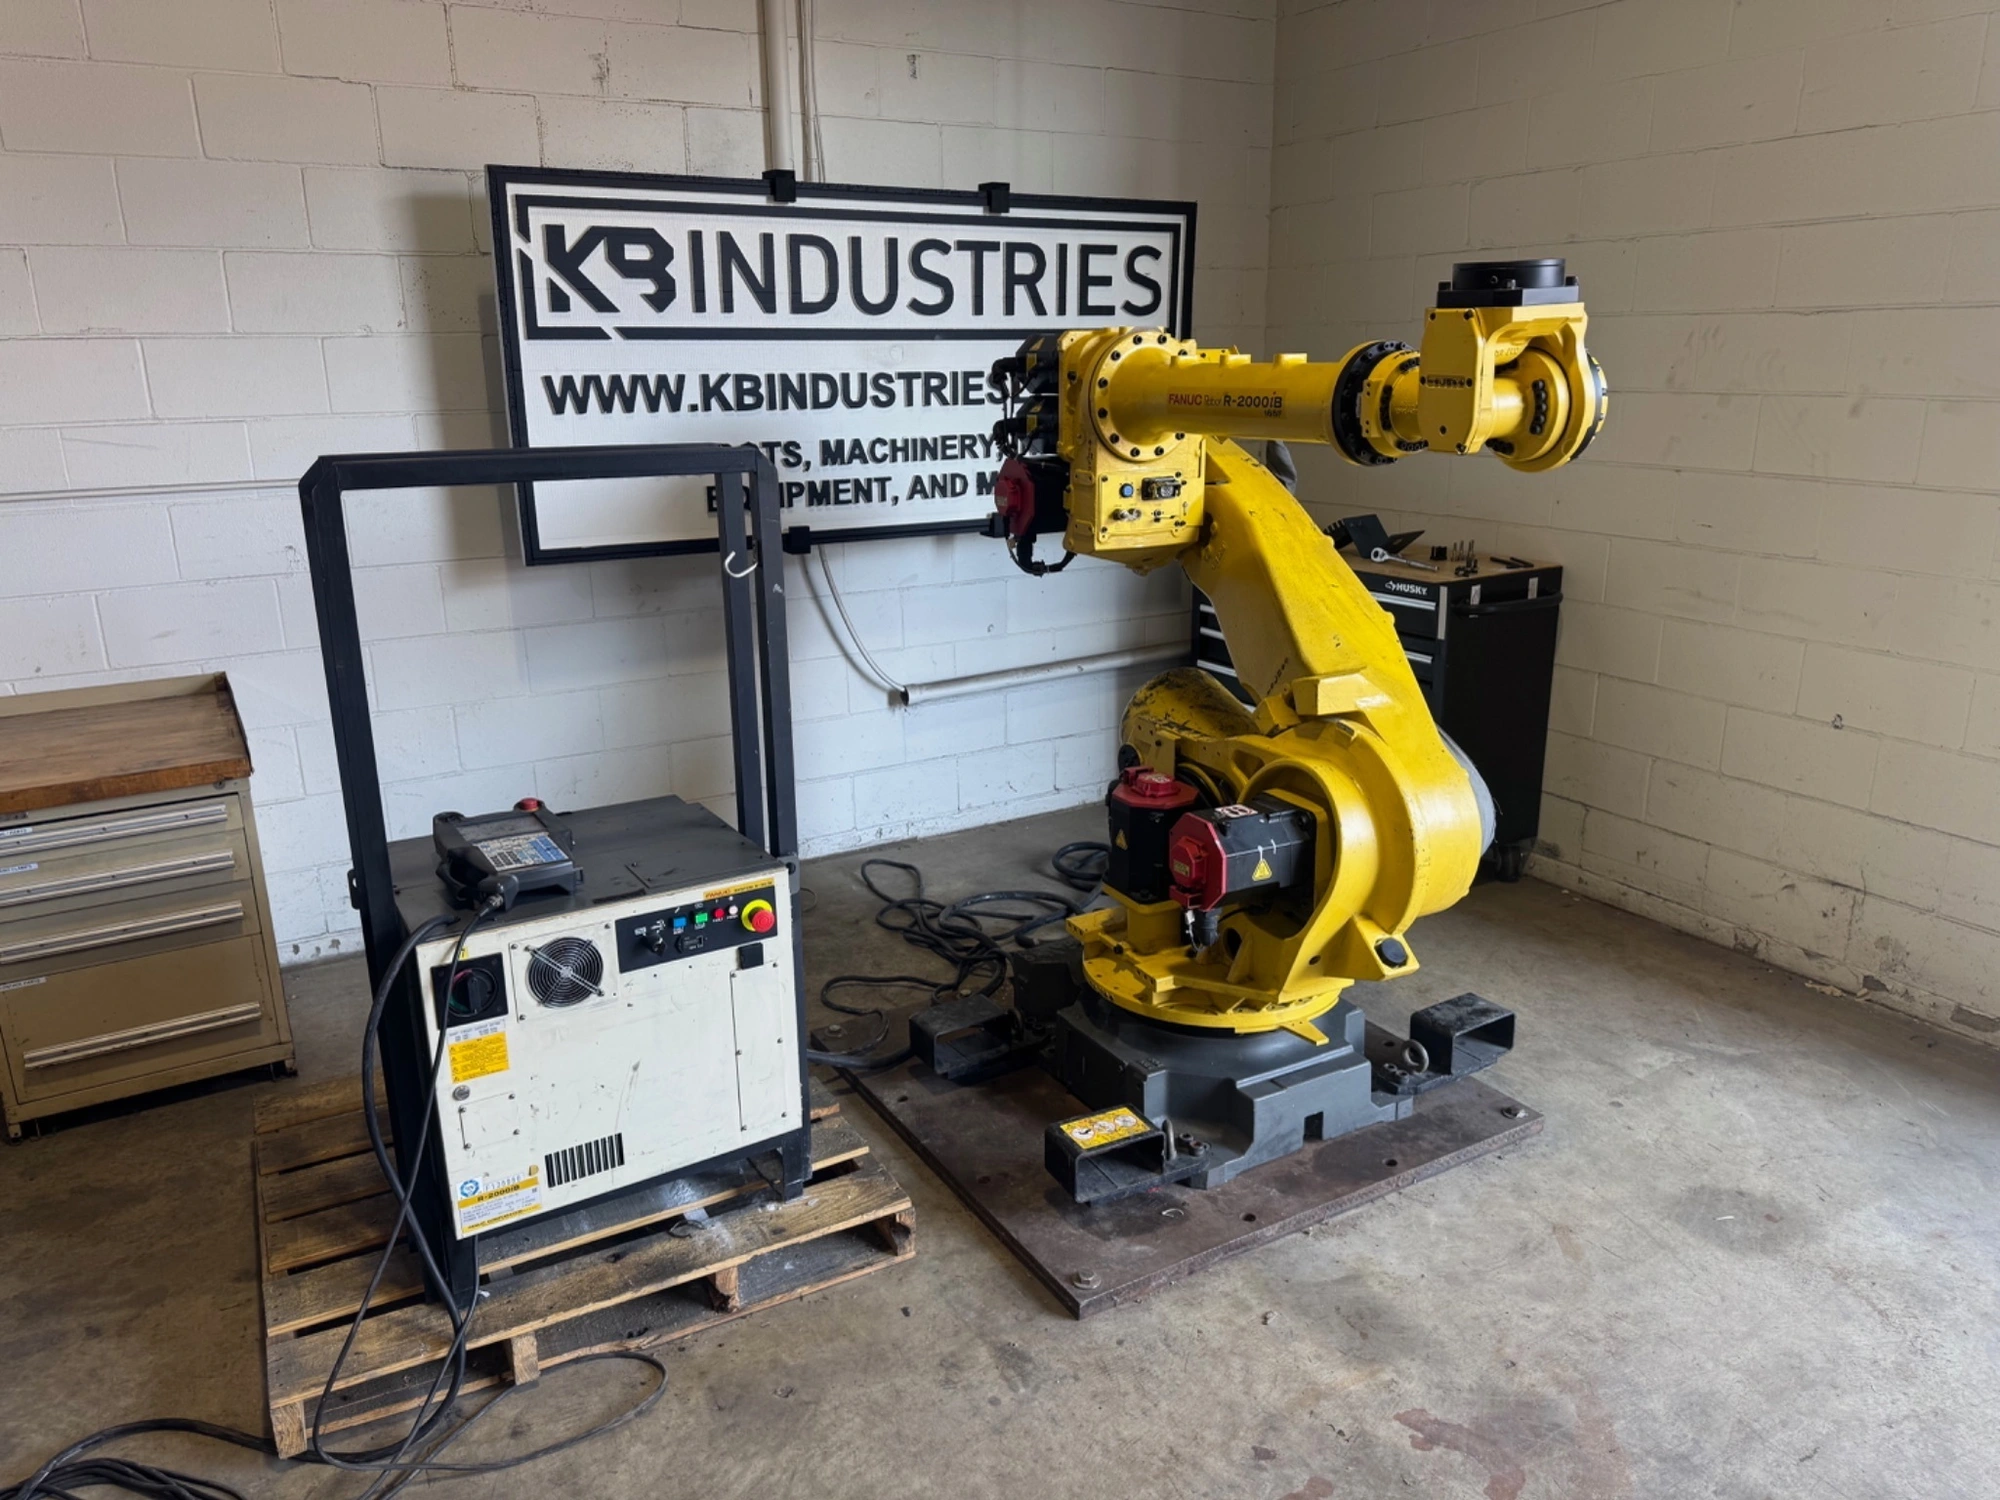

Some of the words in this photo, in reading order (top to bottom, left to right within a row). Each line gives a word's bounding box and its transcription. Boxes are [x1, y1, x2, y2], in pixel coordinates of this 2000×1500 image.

[1168, 393, 1202, 405] FANUC
[706, 476, 899, 513] EIPMENT,
[906, 472, 969, 500] AND
[1396, 583, 1428, 595] HUSKY
